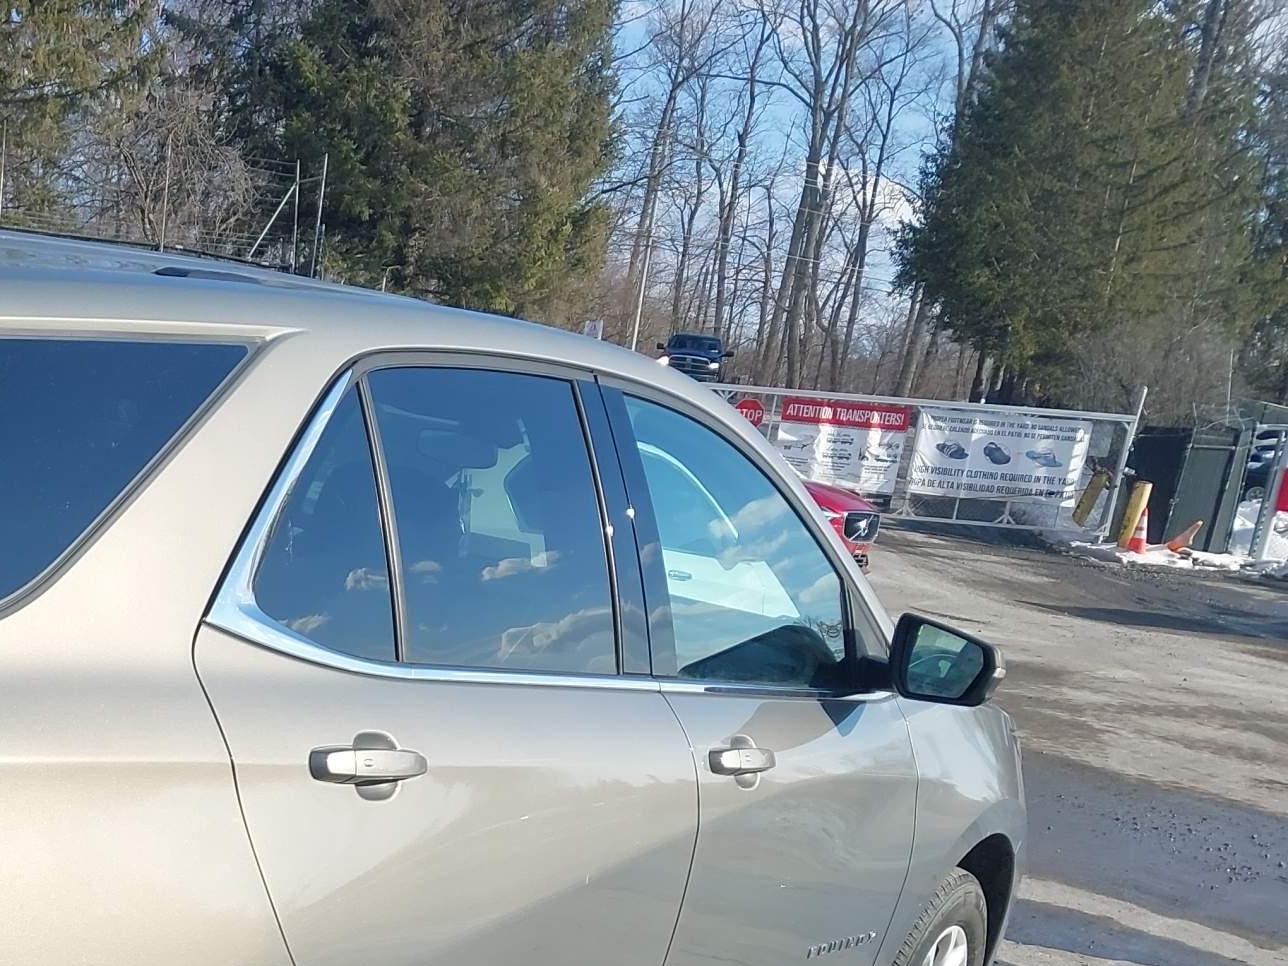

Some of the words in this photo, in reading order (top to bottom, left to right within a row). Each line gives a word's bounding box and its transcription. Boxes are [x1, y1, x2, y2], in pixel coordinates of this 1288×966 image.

[736, 408, 763, 422] TOP
[786, 403, 833, 419] ATTENTION
[836, 407, 905, 425] TRANSPORTERS!
[930, 466, 965, 477] VISIBILITY
[966, 469, 998, 480] CLOTHING
[999, 472, 1033, 483] REQUIRED
[1033, 475, 1041, 484] IN
[1043, 476, 1056, 485] THE
[927, 479, 936, 488] DE
[937, 480, 954, 490] ALTA
[956, 481, 995, 493] VISIBILIDAD
[996, 485, 1033, 496] REQUERIDA
[1034, 488, 1044, 497] EN
